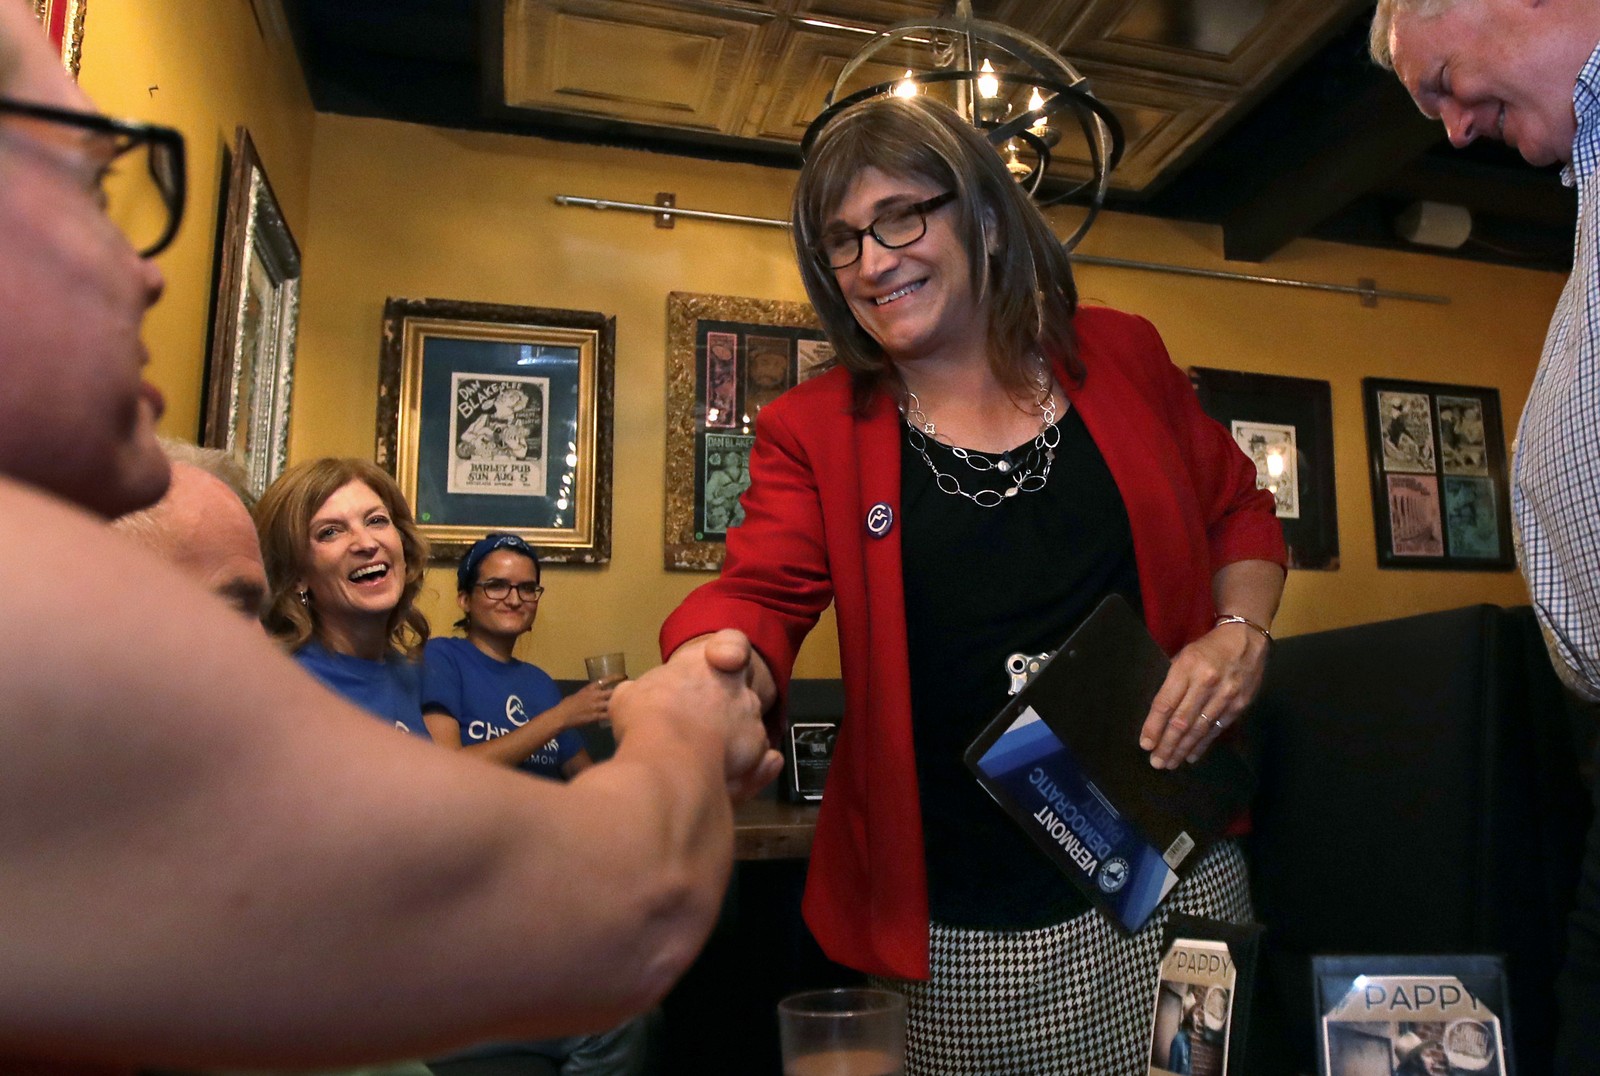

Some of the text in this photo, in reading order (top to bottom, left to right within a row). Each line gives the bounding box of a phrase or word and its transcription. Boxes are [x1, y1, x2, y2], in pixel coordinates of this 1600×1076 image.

[459, 380, 480, 400] DAN
[468, 472, 528, 483] SUN AUG 5
[471, 463, 531, 473] BARLEY PUB
[1029, 767, 1112, 860] DEMOCRATIC
[1033, 805, 1098, 877] VERMONT
